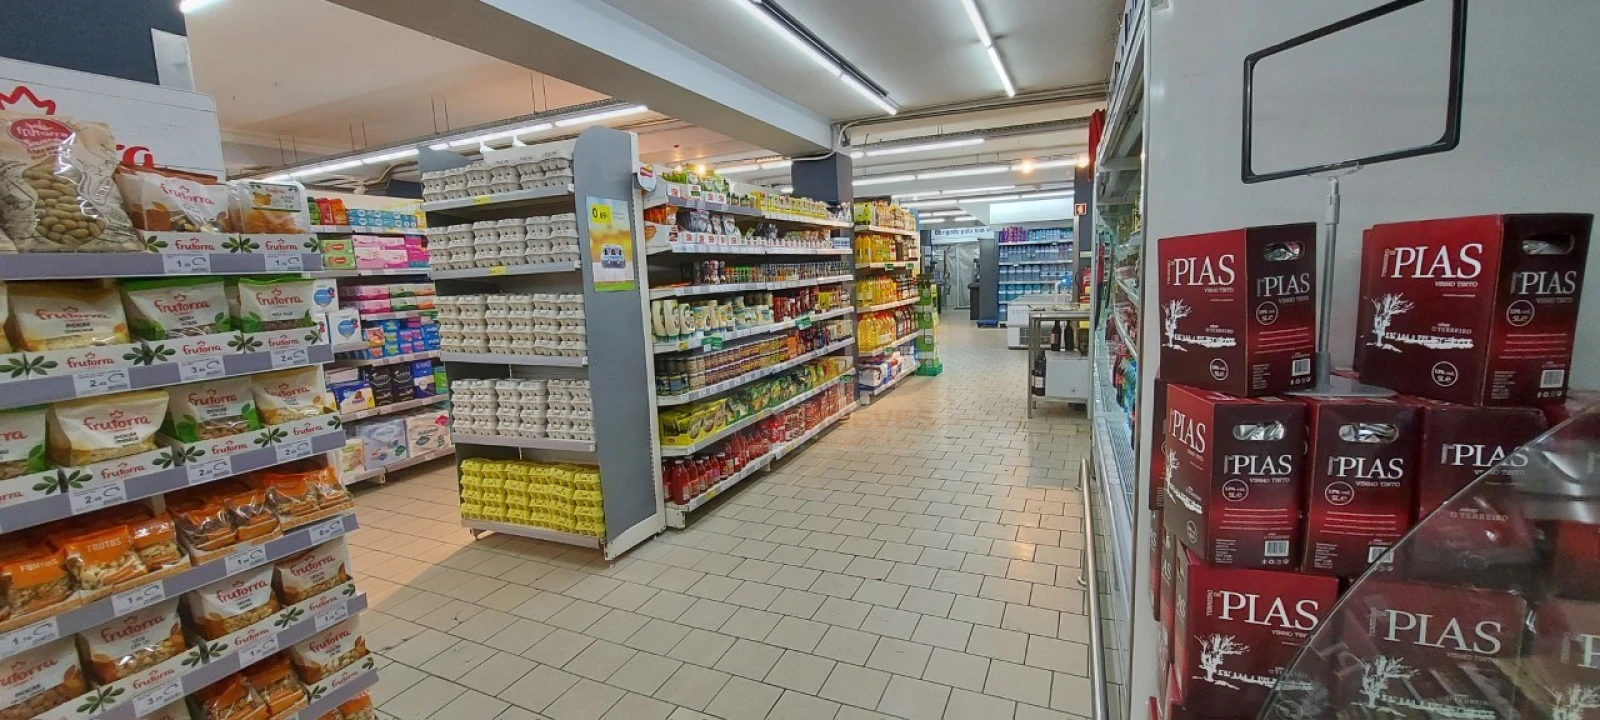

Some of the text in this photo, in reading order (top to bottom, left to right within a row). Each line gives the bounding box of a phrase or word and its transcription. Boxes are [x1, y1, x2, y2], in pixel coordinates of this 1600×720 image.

[175, 240, 215, 251] frutorra
[265, 240, 298, 251] frutorra
[1173, 254, 1236, 286] PIAS
[1390, 243, 1483, 279] PIAS
[1263, 272, 1310, 297] PIAS
[1518, 270, 1577, 295] PIAS
[154, 299, 211, 313] frutorra
[256, 291, 304, 306] frutorra
[183, 344, 222, 356] frutorra
[67, 357, 116, 369] frutorra
[188, 393, 237, 406] frutorra
[83, 415, 152, 431] frutorra
[1172, 409, 1206, 453] PIAS
[212, 442, 248, 456] frutorra
[1451, 444, 1530, 467] PIAS
[101, 465, 146, 480] frutorra
[1231, 454, 1292, 475] PIAS
[1335, 456, 1404, 480] PIAS
[1459, 512, 1509, 522] TERREIRO
[87, 537, 122, 552] FRUTOS
[20, 558, 60, 572] FRUTOS
[289, 554, 336, 577] frutorra
[216, 578, 269, 604] frutorra
[1218, 590, 1319, 631] PIAS
[100, 614, 166, 643] frutorra
[1383, 609, 1501, 655] PIAS
[309, 629, 351, 653] frutorra
